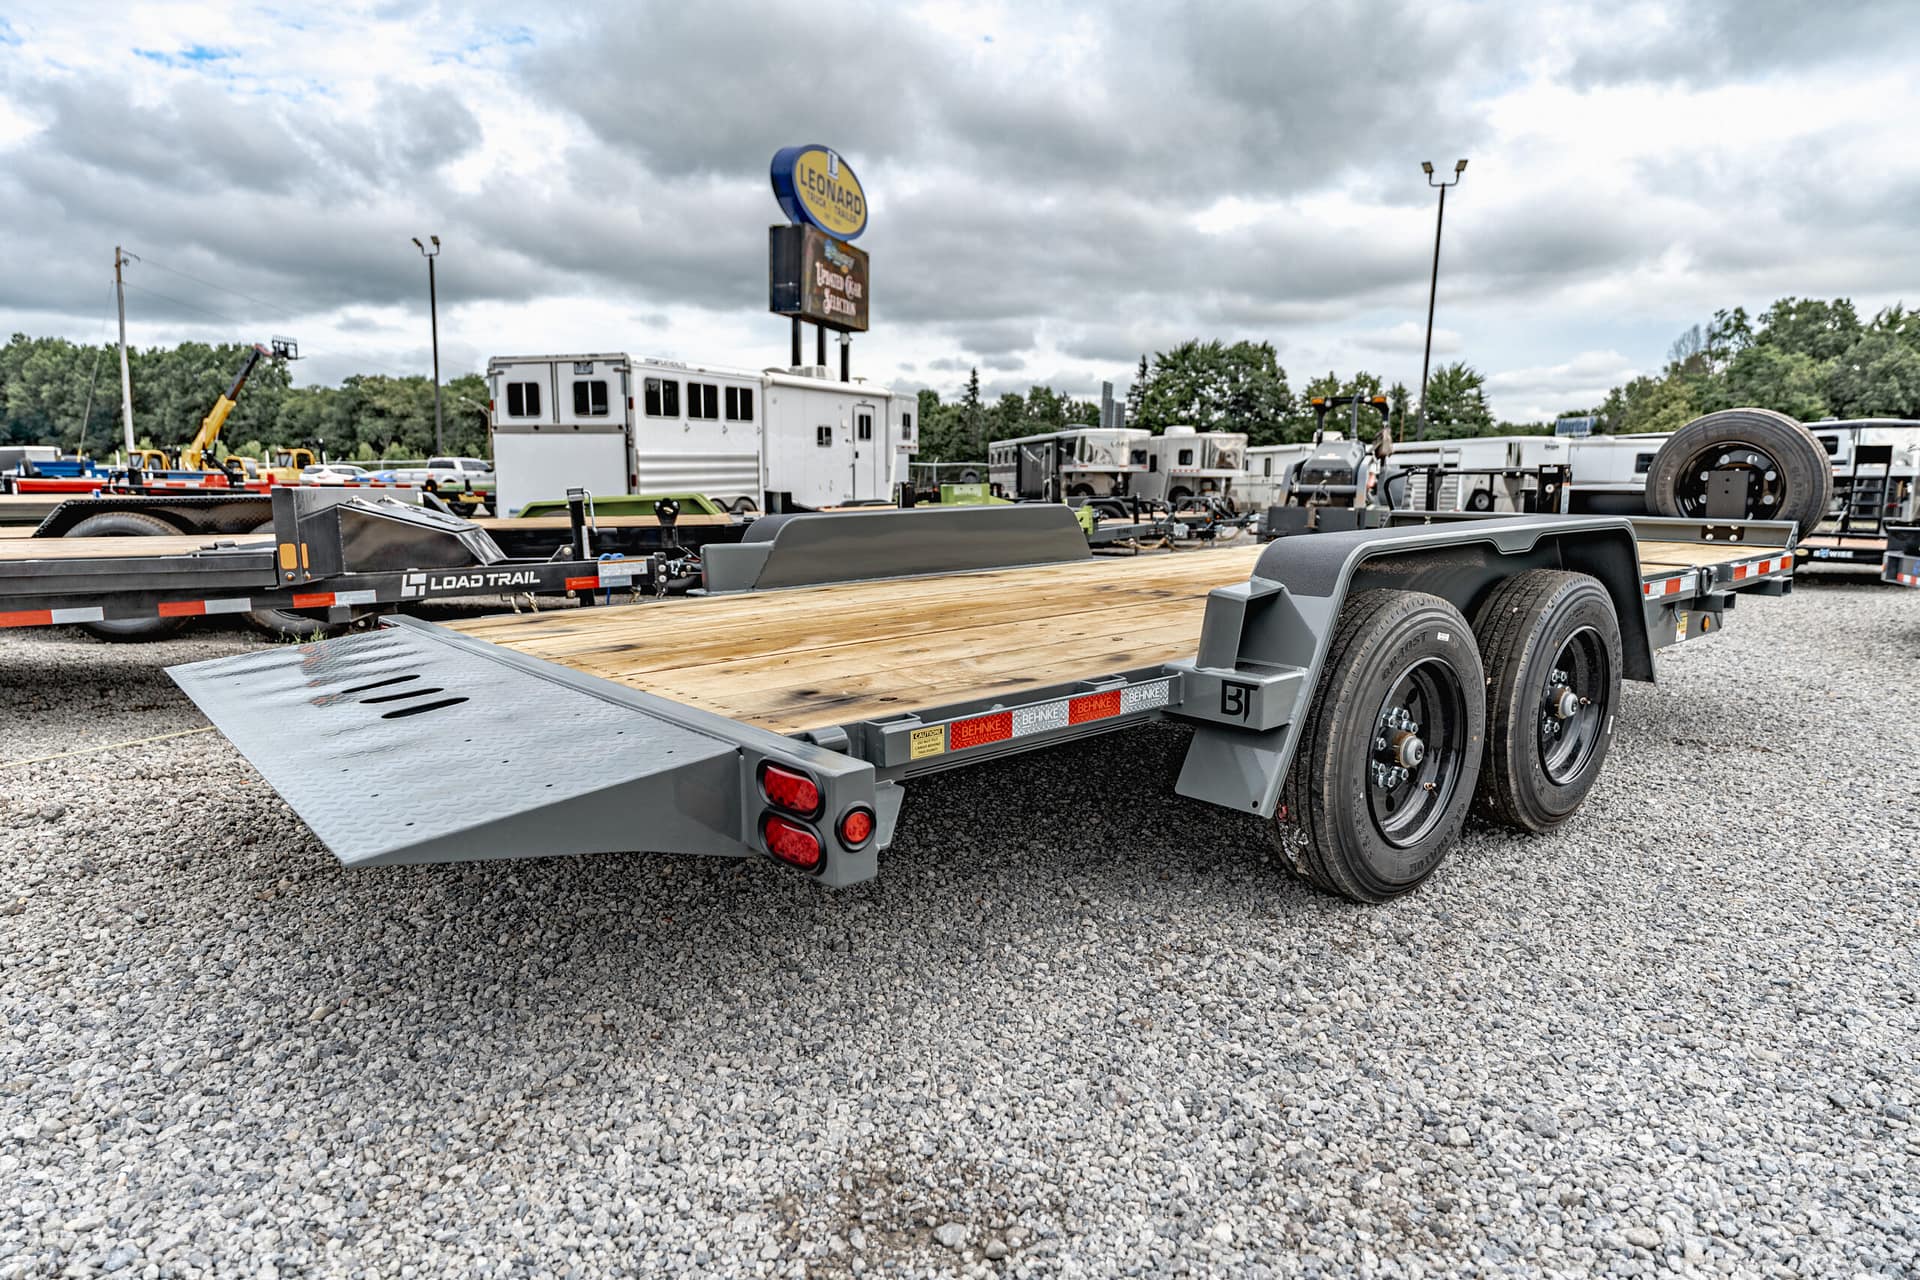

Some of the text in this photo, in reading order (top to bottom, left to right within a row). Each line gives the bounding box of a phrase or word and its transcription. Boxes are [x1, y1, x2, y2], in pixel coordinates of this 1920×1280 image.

[799, 163, 862, 216] LEONARD
[430, 573, 484, 591] LOAD
[485, 570, 541, 587] TRAIL
[962, 719, 1002, 739] BEHNKE
[1022, 708, 1059, 726] BEHNKE
[1077, 697, 1112, 714] BEHNKE
[1128, 687, 1161, 704] BEHNKE
[1221, 679, 1259, 723] BT
